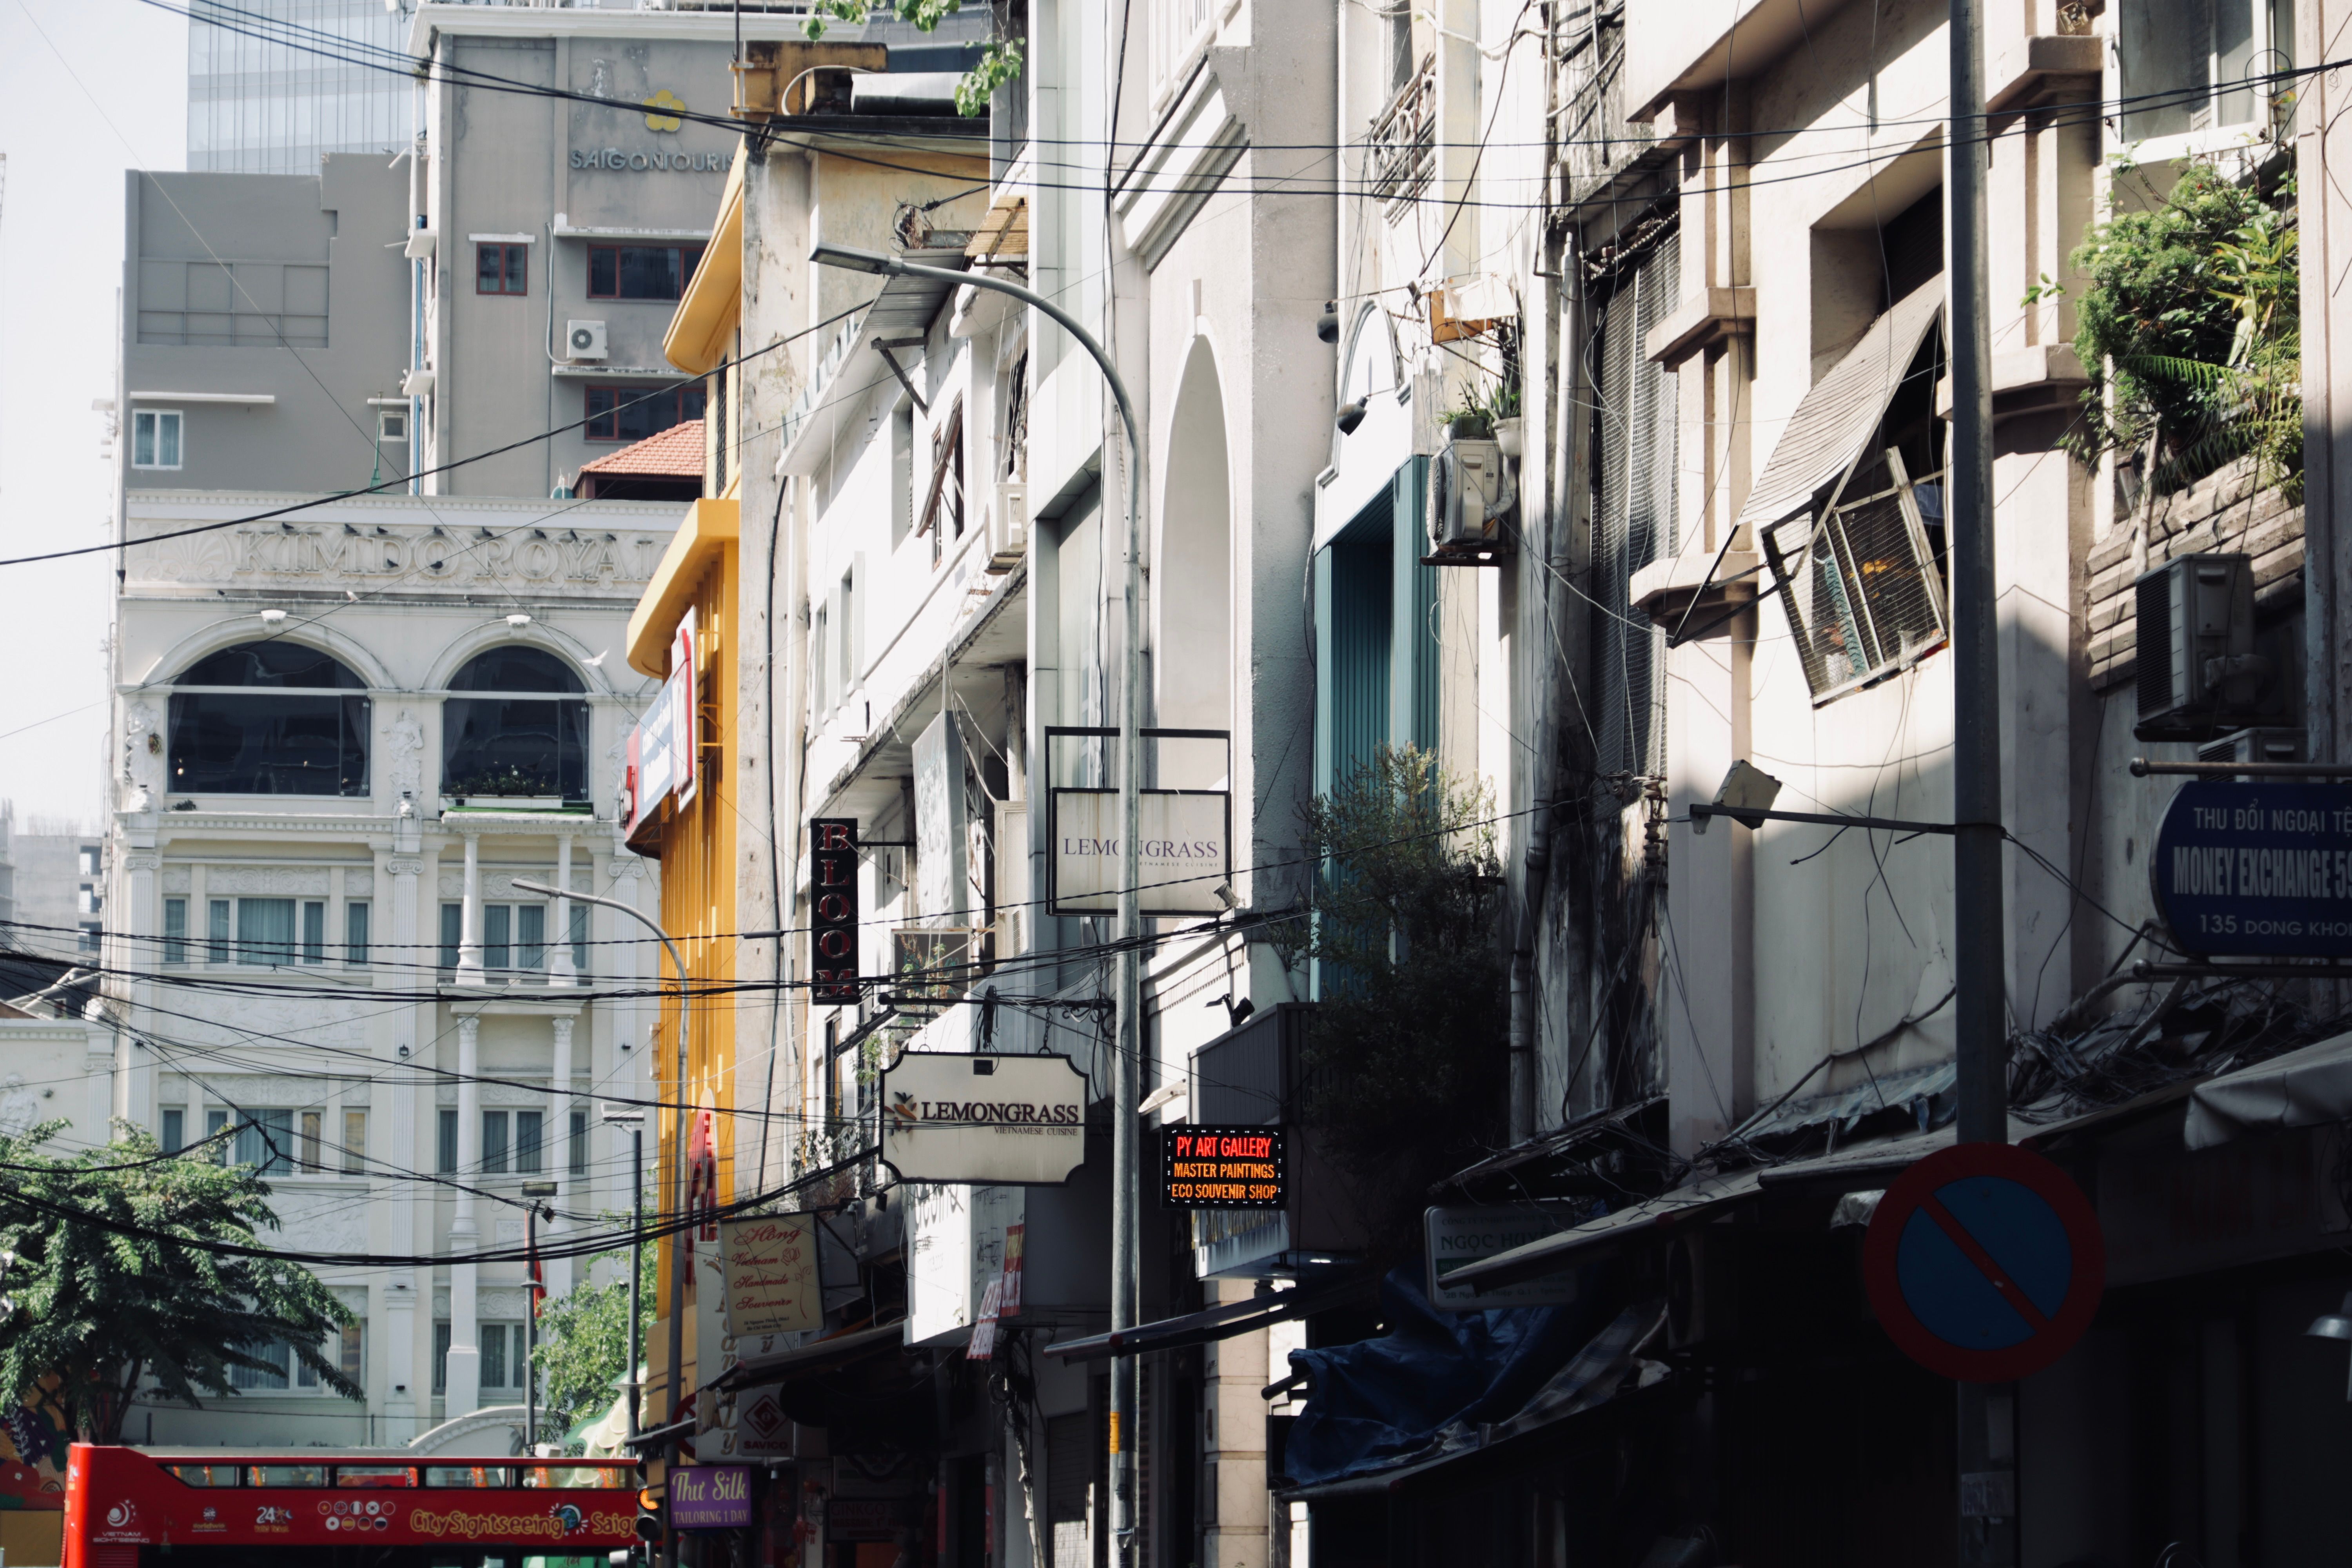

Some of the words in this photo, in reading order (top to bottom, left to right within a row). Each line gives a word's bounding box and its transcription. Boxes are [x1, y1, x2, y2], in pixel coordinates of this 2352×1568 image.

[2194, 807, 2227, 830] THU
[2235, 798, 2264, 831] ĐỔI
[2272, 809, 2325, 836] NGOẠI
[2333, 806, 2352, 837] TỆ
[1063, 838, 1218, 858] LEMGRASS
[2173, 846, 2235, 896] MONEY
[2239, 848, 2331, 898] EXCHANGE
[816, 823, 856, 998] BLOOM
[2200, 914, 2238, 934] 135
[2245, 920, 2303, 935] DONG
[921, 1102, 1079, 1124] LEMONGRASS
[994, 1126, 1044, 1135] VIETNAMESE
[1047, 1127, 1078, 1136] CUISINE
[1177, 1136, 1192, 1157] PY
[1196, 1137, 1218, 1157] ART
[1220, 1137, 1272, 1158] GALLERY
[1174, 1163, 1217, 1178] MASTER
[1220, 1163, 1275, 1179] PAINTINGS
[1172, 1184, 1193, 1198] ECO
[1195, 1184, 1246, 1199] SOUVENIR
[1249, 1184, 1278, 1200] SHOP
[733, 1224, 801, 1246] Hồng
[1440, 1234, 1493, 1252] NGỌC
[731, 1252, 778, 1267] Vietnam
[733, 1274, 788, 1289] Handmade
[735, 1297, 792, 1310] Souvenir
[743, 1440, 788, 1450] SAVICO
[671, 1472, 706, 1502] Thư
[712, 1470, 748, 1501] Silk
[256, 1506, 276, 1524] 24
[673, 1510, 721, 1524] TAILORING
[724, 1510, 728, 1523] 1
[730, 1510, 748, 1523] DAY
[831, 1502, 886, 1516] GINKGO
